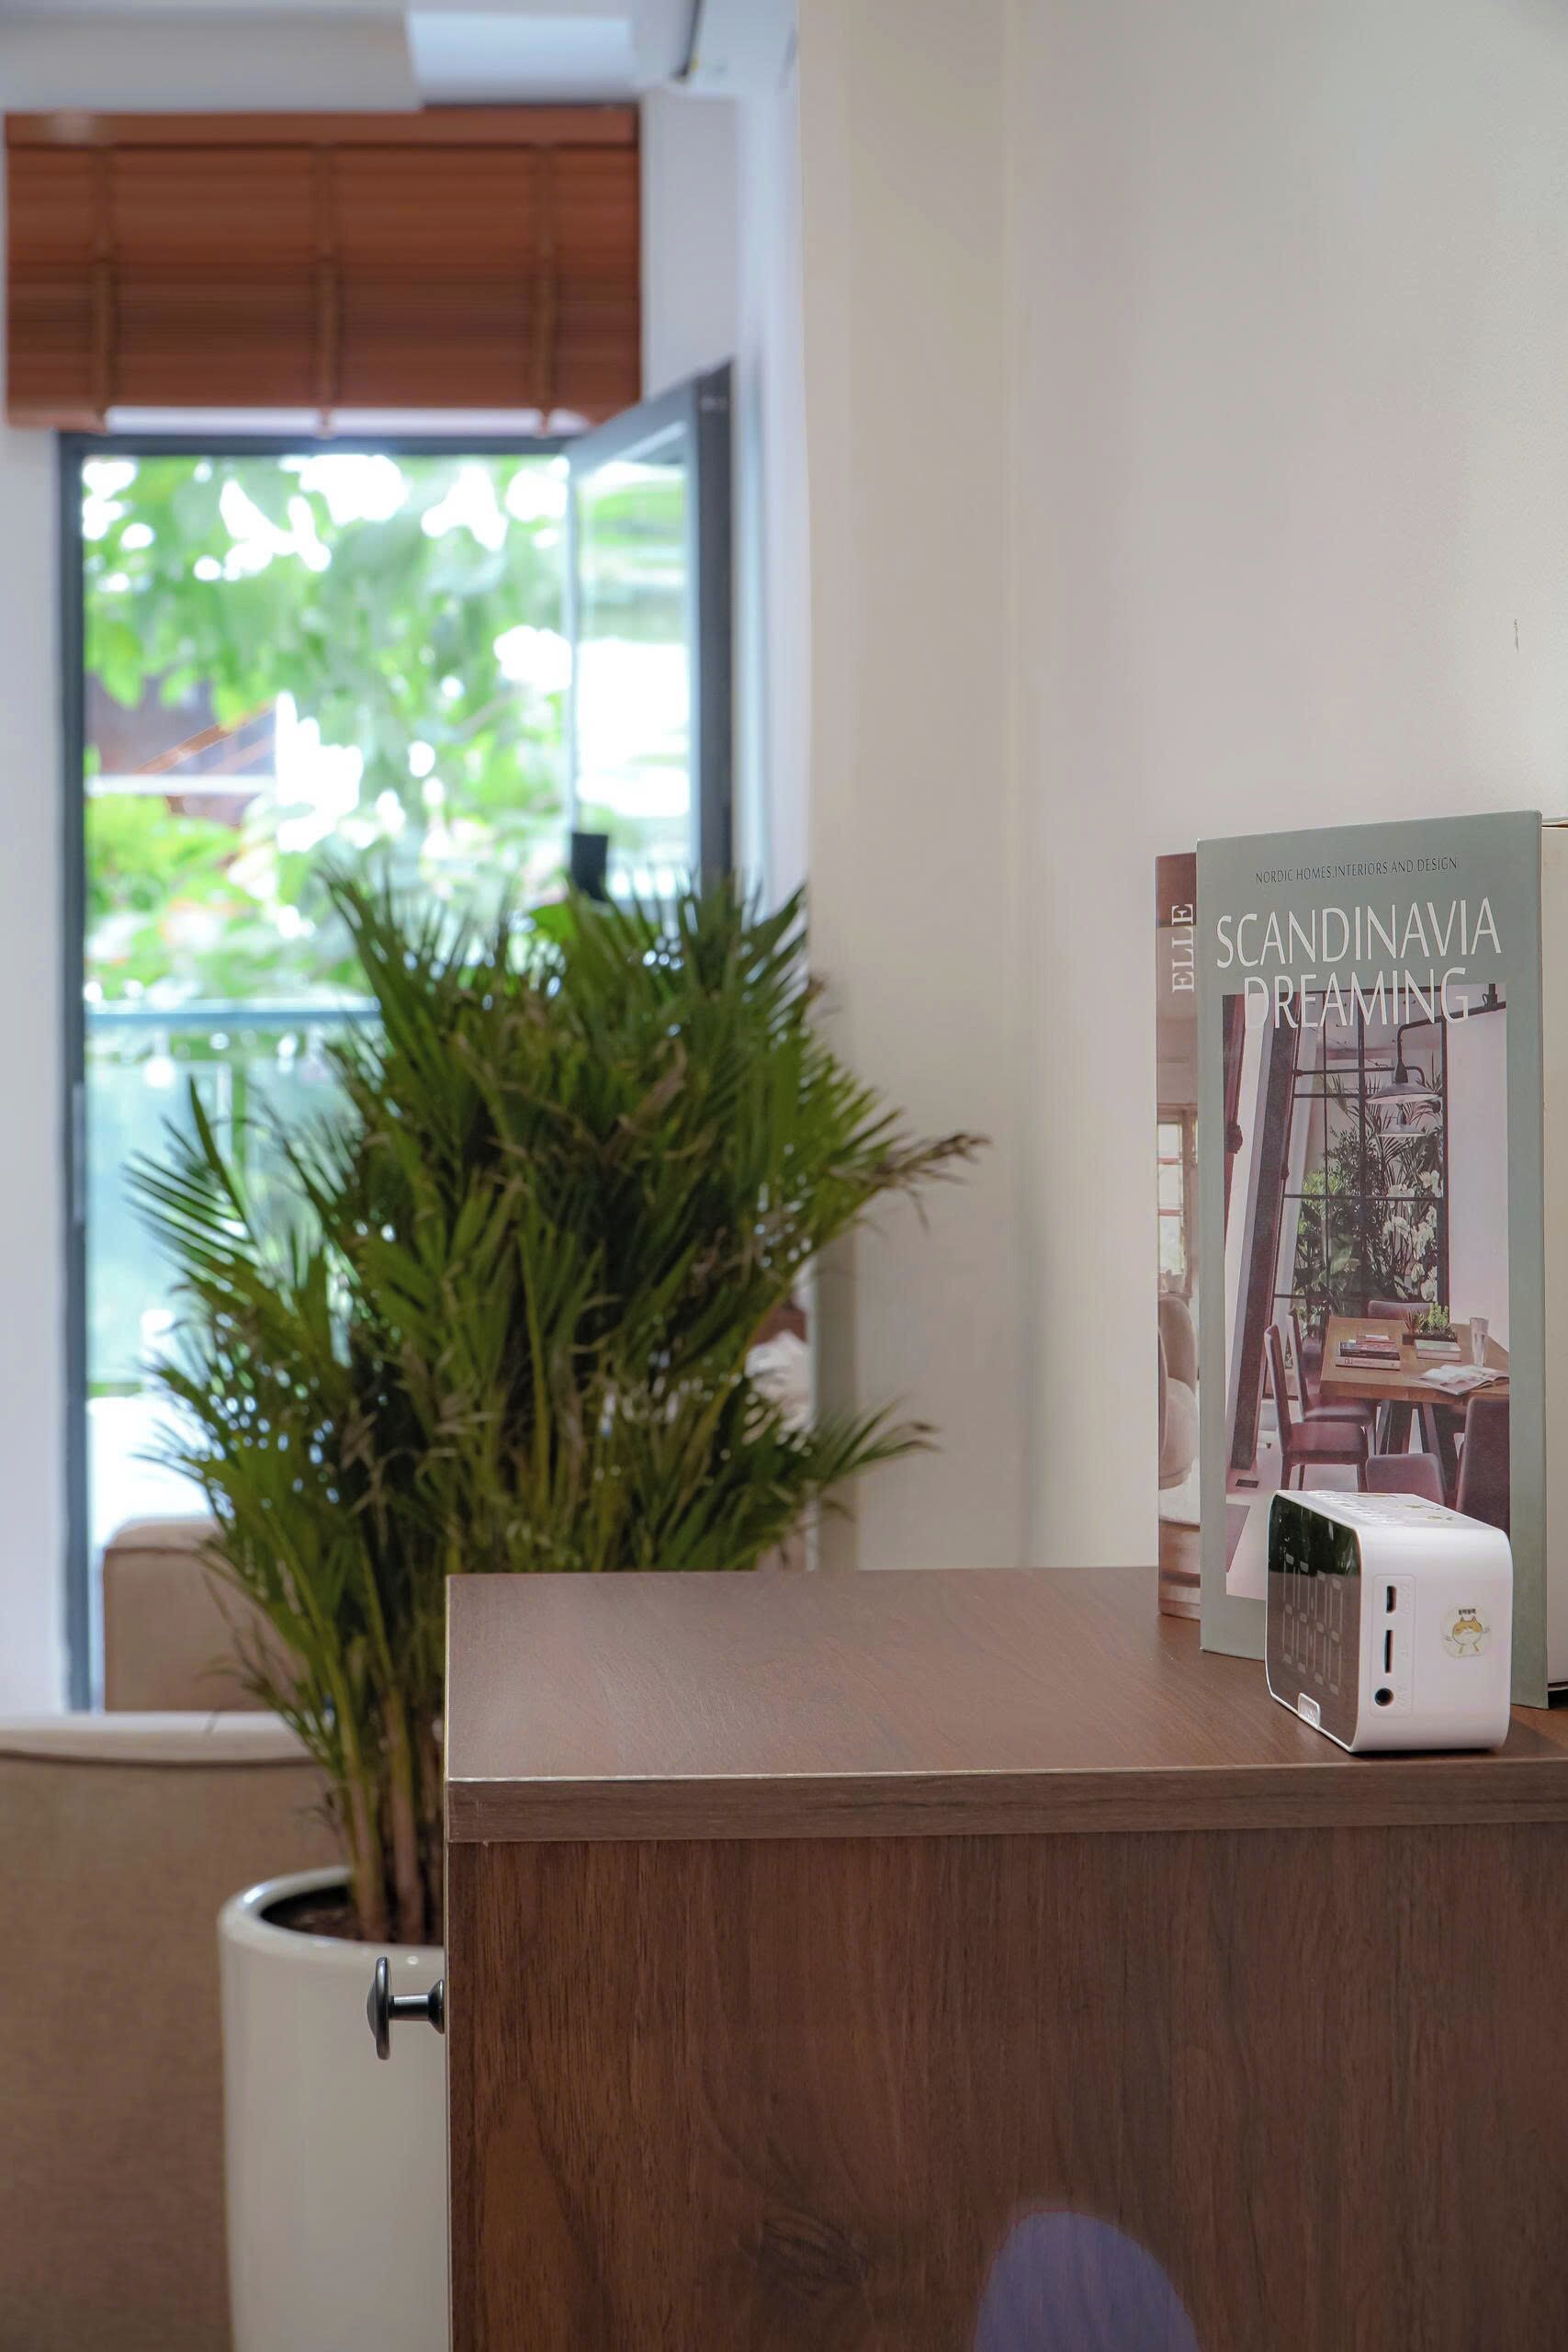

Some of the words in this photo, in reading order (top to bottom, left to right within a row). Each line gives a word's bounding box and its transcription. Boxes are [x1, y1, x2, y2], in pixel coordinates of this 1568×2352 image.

[1256, 869, 1293, 884] NORDIC
[1391, 859, 1414, 874] AND
[1416, 856, 1457, 872] DESIGN
[1171, 903, 1194, 993] ELLE
[1216, 897, 1502, 968] SCANDINAVIA
[1244, 967, 1469, 1030] DREAMING
